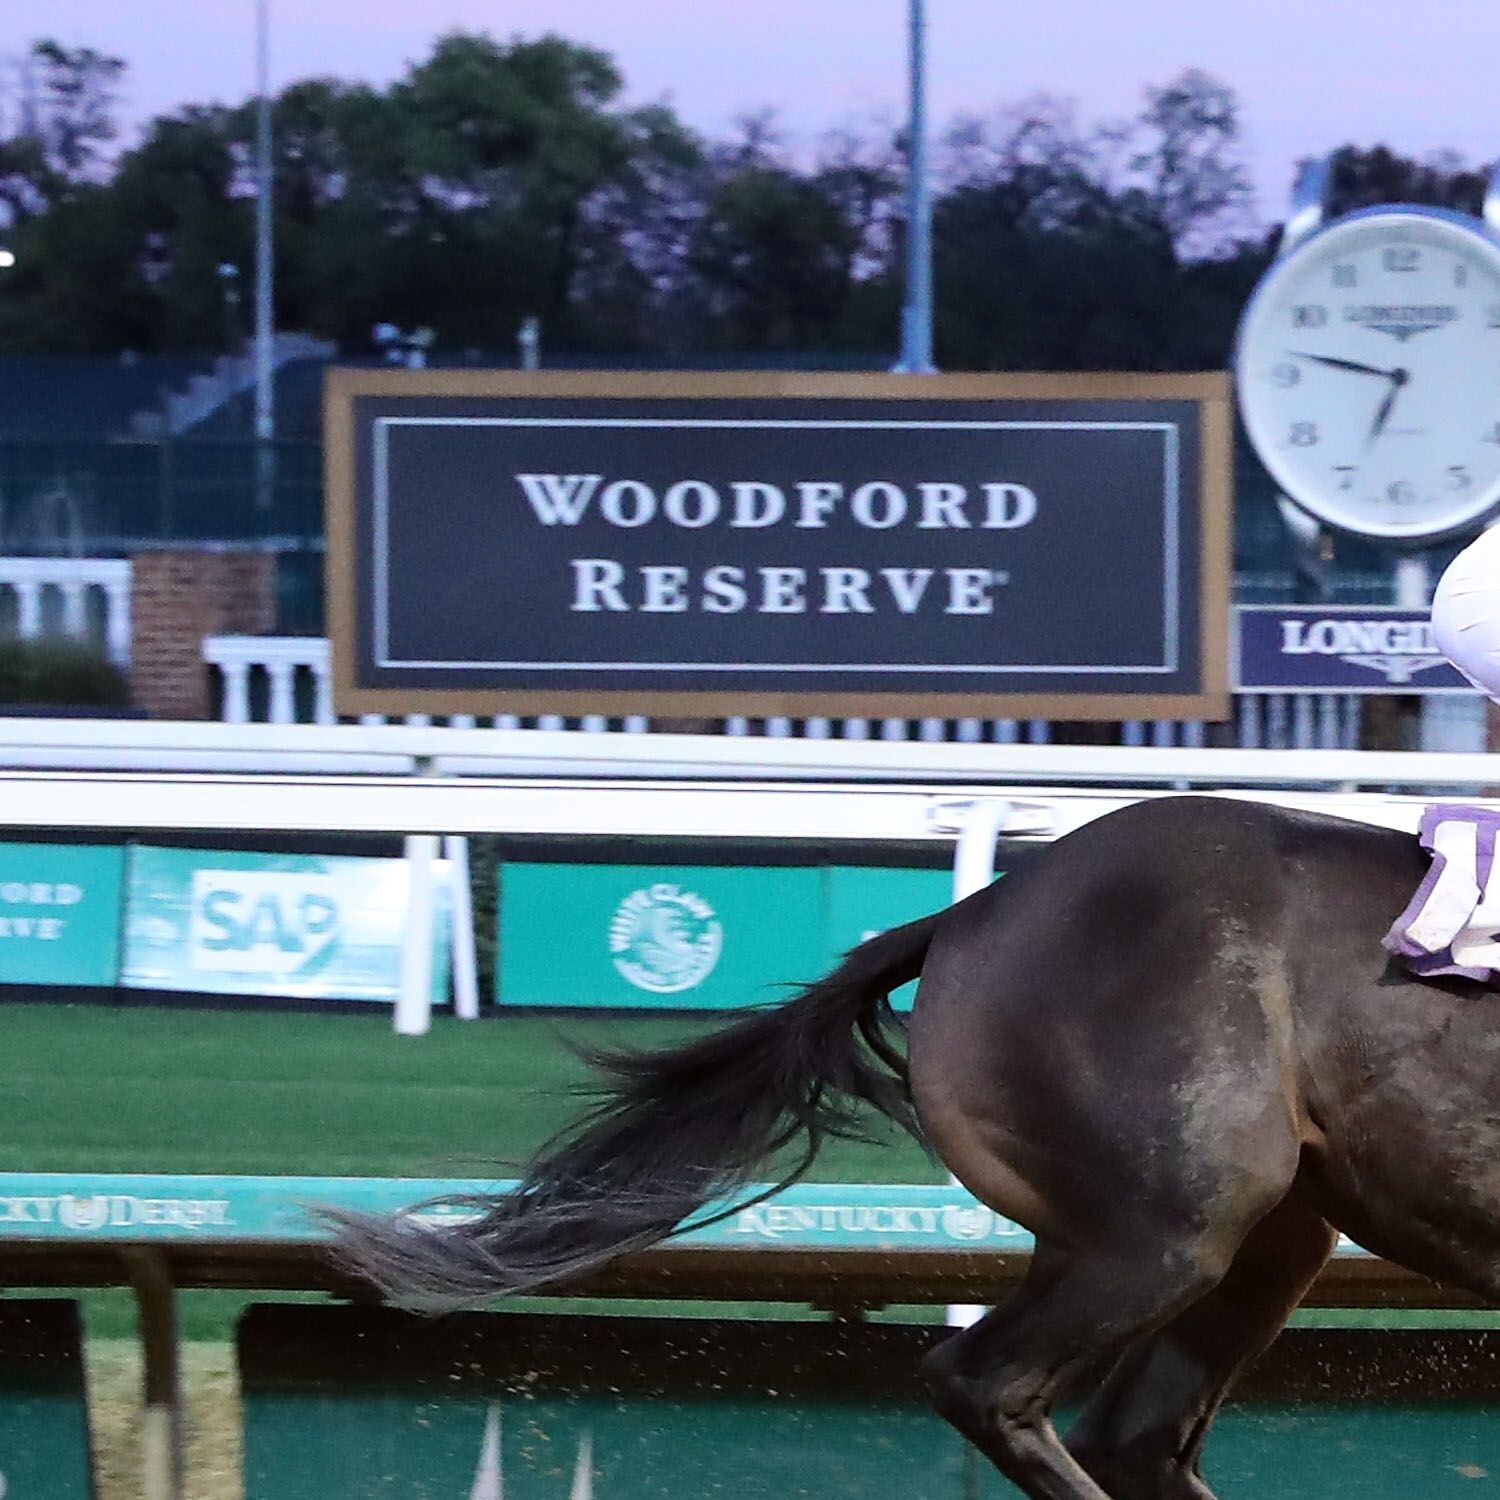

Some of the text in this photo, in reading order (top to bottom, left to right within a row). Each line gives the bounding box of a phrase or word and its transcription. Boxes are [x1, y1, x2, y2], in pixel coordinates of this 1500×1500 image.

[515, 474, 1038, 531] WOODFORD
[569, 558, 998, 616] RESERVE
[1280, 619, 1444, 655] LONGI
[202, 889, 339, 952] SAP
[735, 1201, 944, 1239] KENTUCKY
